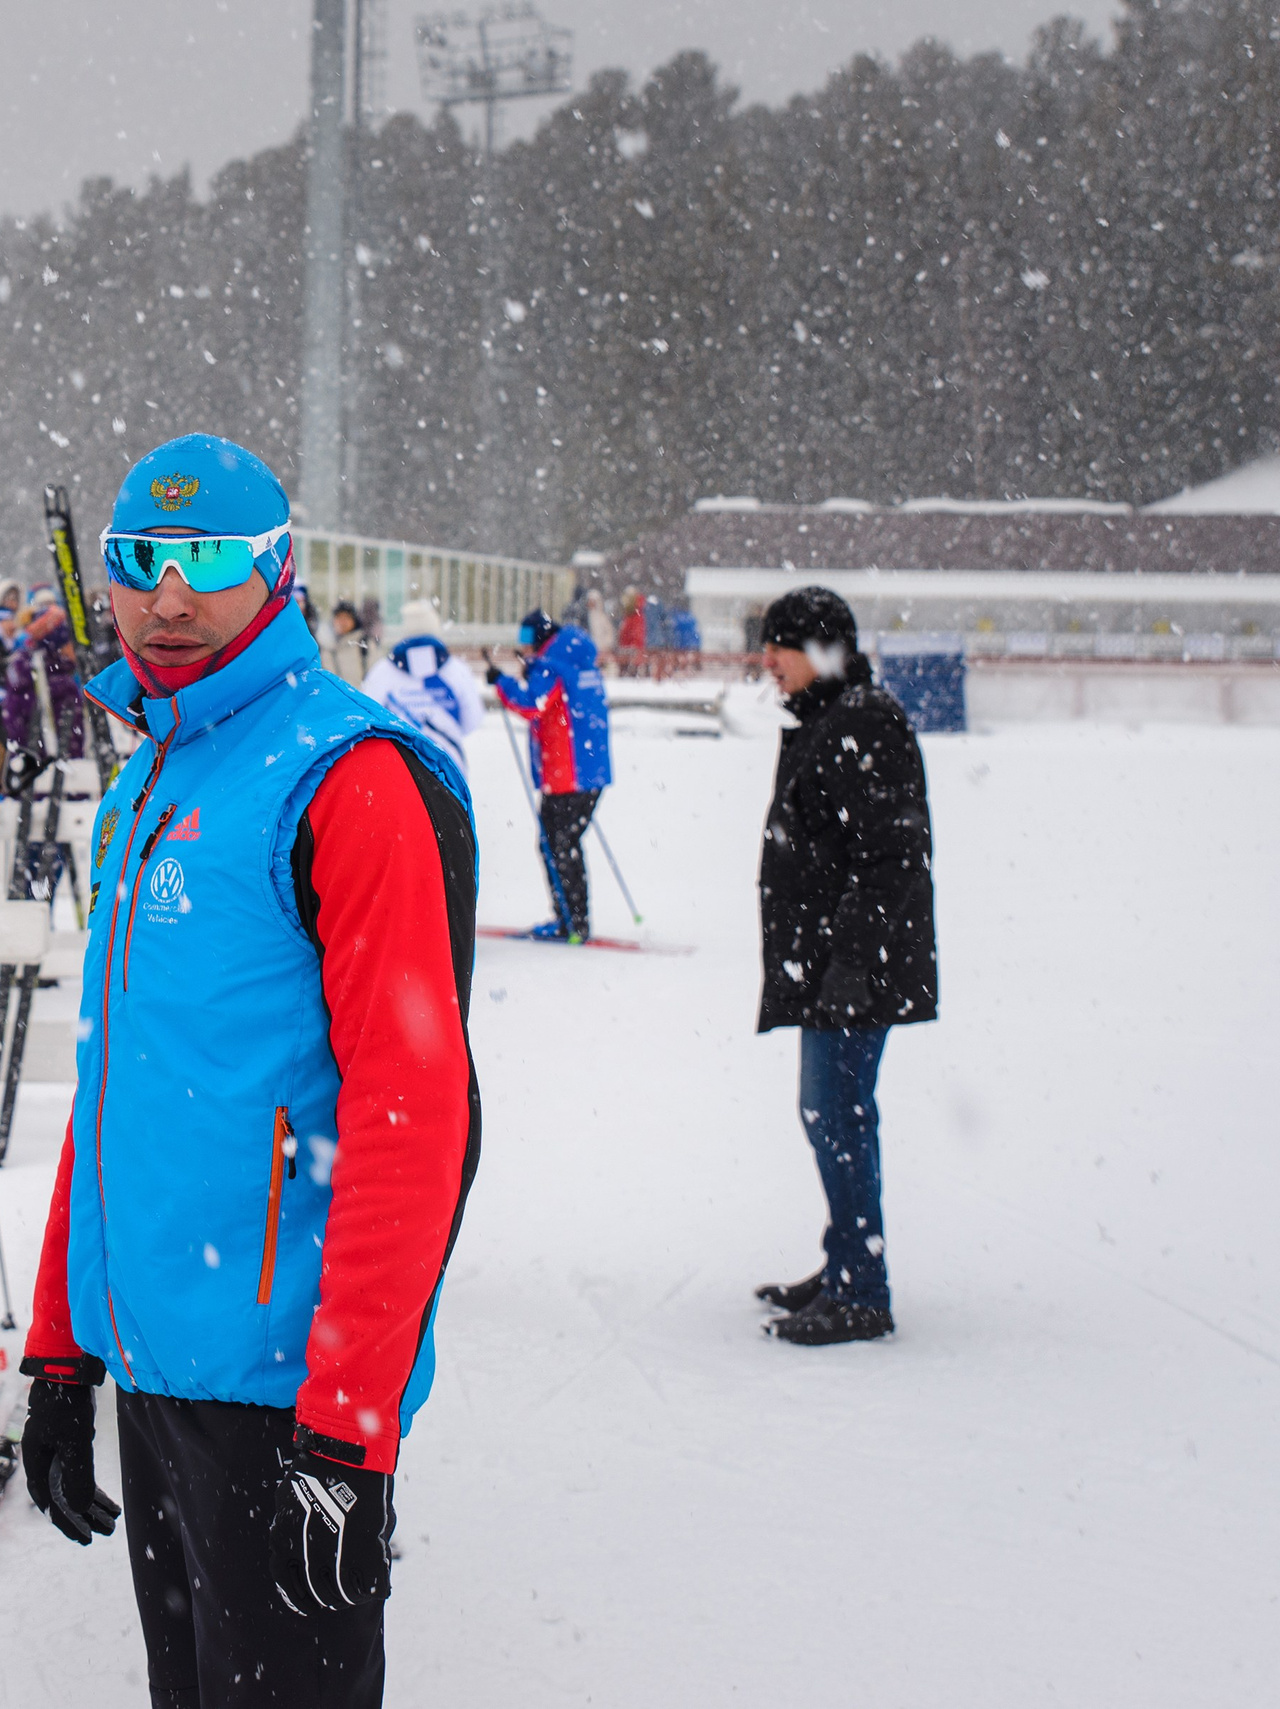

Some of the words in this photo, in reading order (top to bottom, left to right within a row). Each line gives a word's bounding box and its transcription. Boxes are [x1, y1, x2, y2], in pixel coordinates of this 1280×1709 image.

[165, 828, 201, 841] adidas
[299, 1479, 314, 1502] PRO
[313, 1502, 338, 1534] COLD
